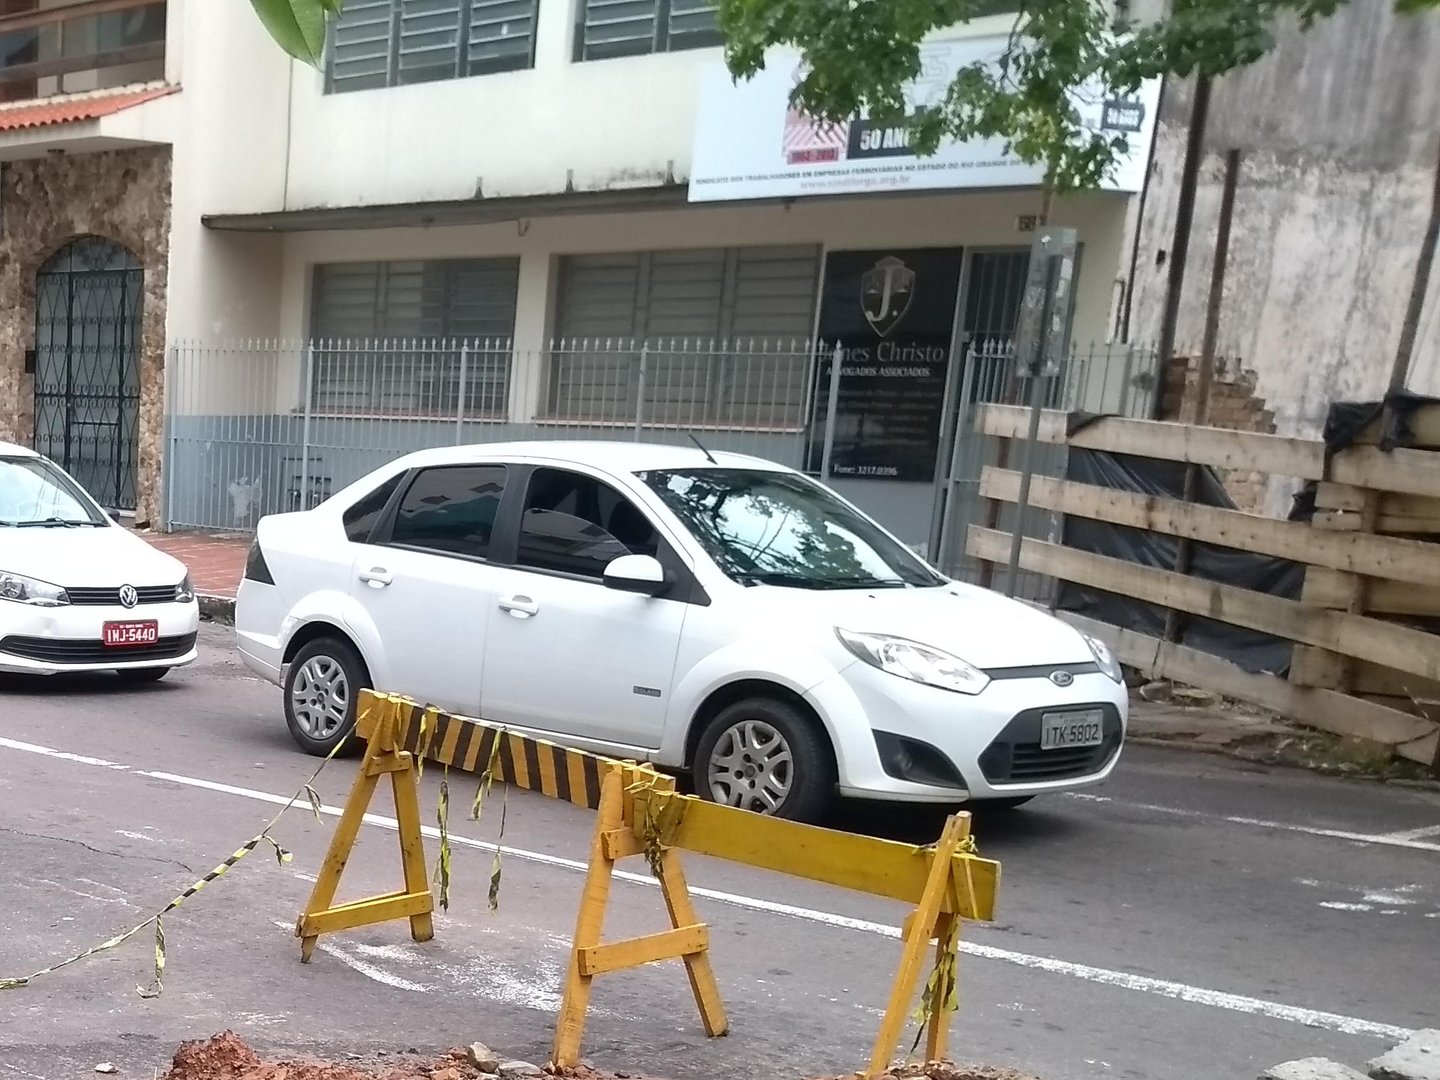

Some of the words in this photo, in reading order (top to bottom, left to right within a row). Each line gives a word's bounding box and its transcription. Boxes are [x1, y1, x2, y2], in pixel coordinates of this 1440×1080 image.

[860, 128, 881, 151] 50
[882, 126, 910, 149] AN
[745, 171, 800, 181] TRABALHADORES
[877, 341, 944, 362] Christo
[826, 366, 876, 376] AVOGADOS
[878, 366, 931, 377] ASSOCIADOS
[1046, 724, 1099, 746] ITK-5802
